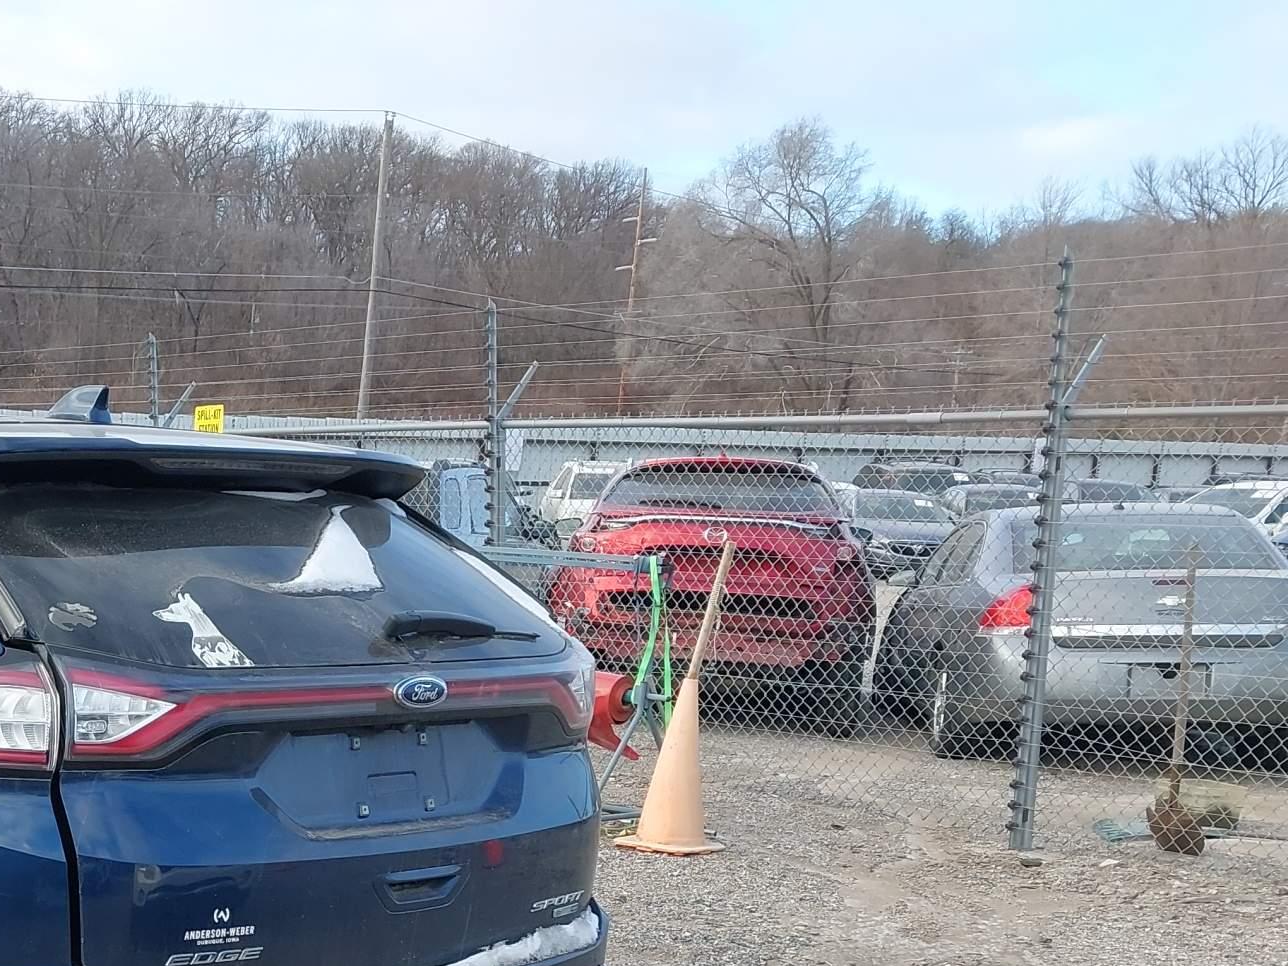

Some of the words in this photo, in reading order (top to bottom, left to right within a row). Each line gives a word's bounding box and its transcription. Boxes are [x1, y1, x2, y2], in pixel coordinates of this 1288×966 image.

[411, 683, 440, 701] Ford
[530, 889, 585, 913] SPORT
[183, 925, 256, 941] ANDERSON-WEBER
[164, 946, 264, 966] EDGE
